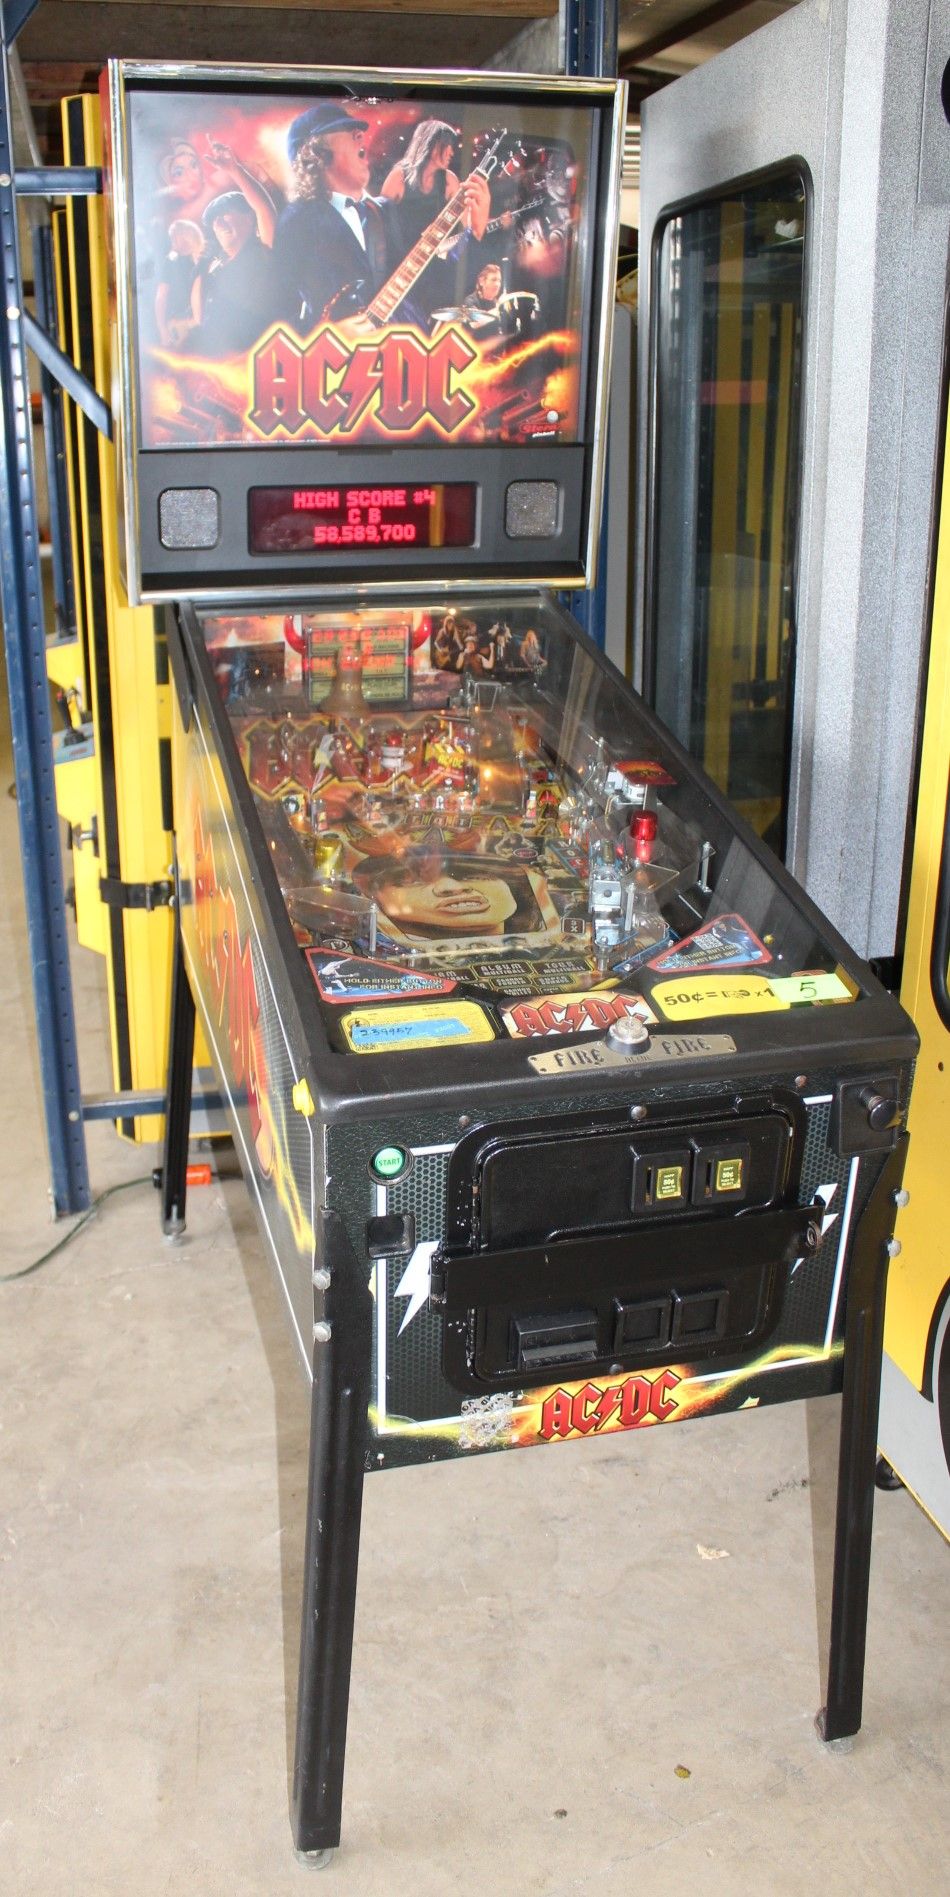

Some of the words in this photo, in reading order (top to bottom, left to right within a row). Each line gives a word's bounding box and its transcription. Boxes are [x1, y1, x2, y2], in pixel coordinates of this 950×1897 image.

[294, 491, 339, 509] HIGH
[346, 489, 407, 507] SCORE
[413, 489, 436, 505] #4
[348, 508, 361, 525] C
[368, 508, 381, 524] B
[314, 524, 416, 545] 58,589,700
[664, 991, 704, 1006] 50¢
[799, 981, 818, 999] 5
[554, 1048, 604, 1067] FIRE
[661, 1037, 712, 1056] FIRE
[379, 1157, 401, 1167] START
